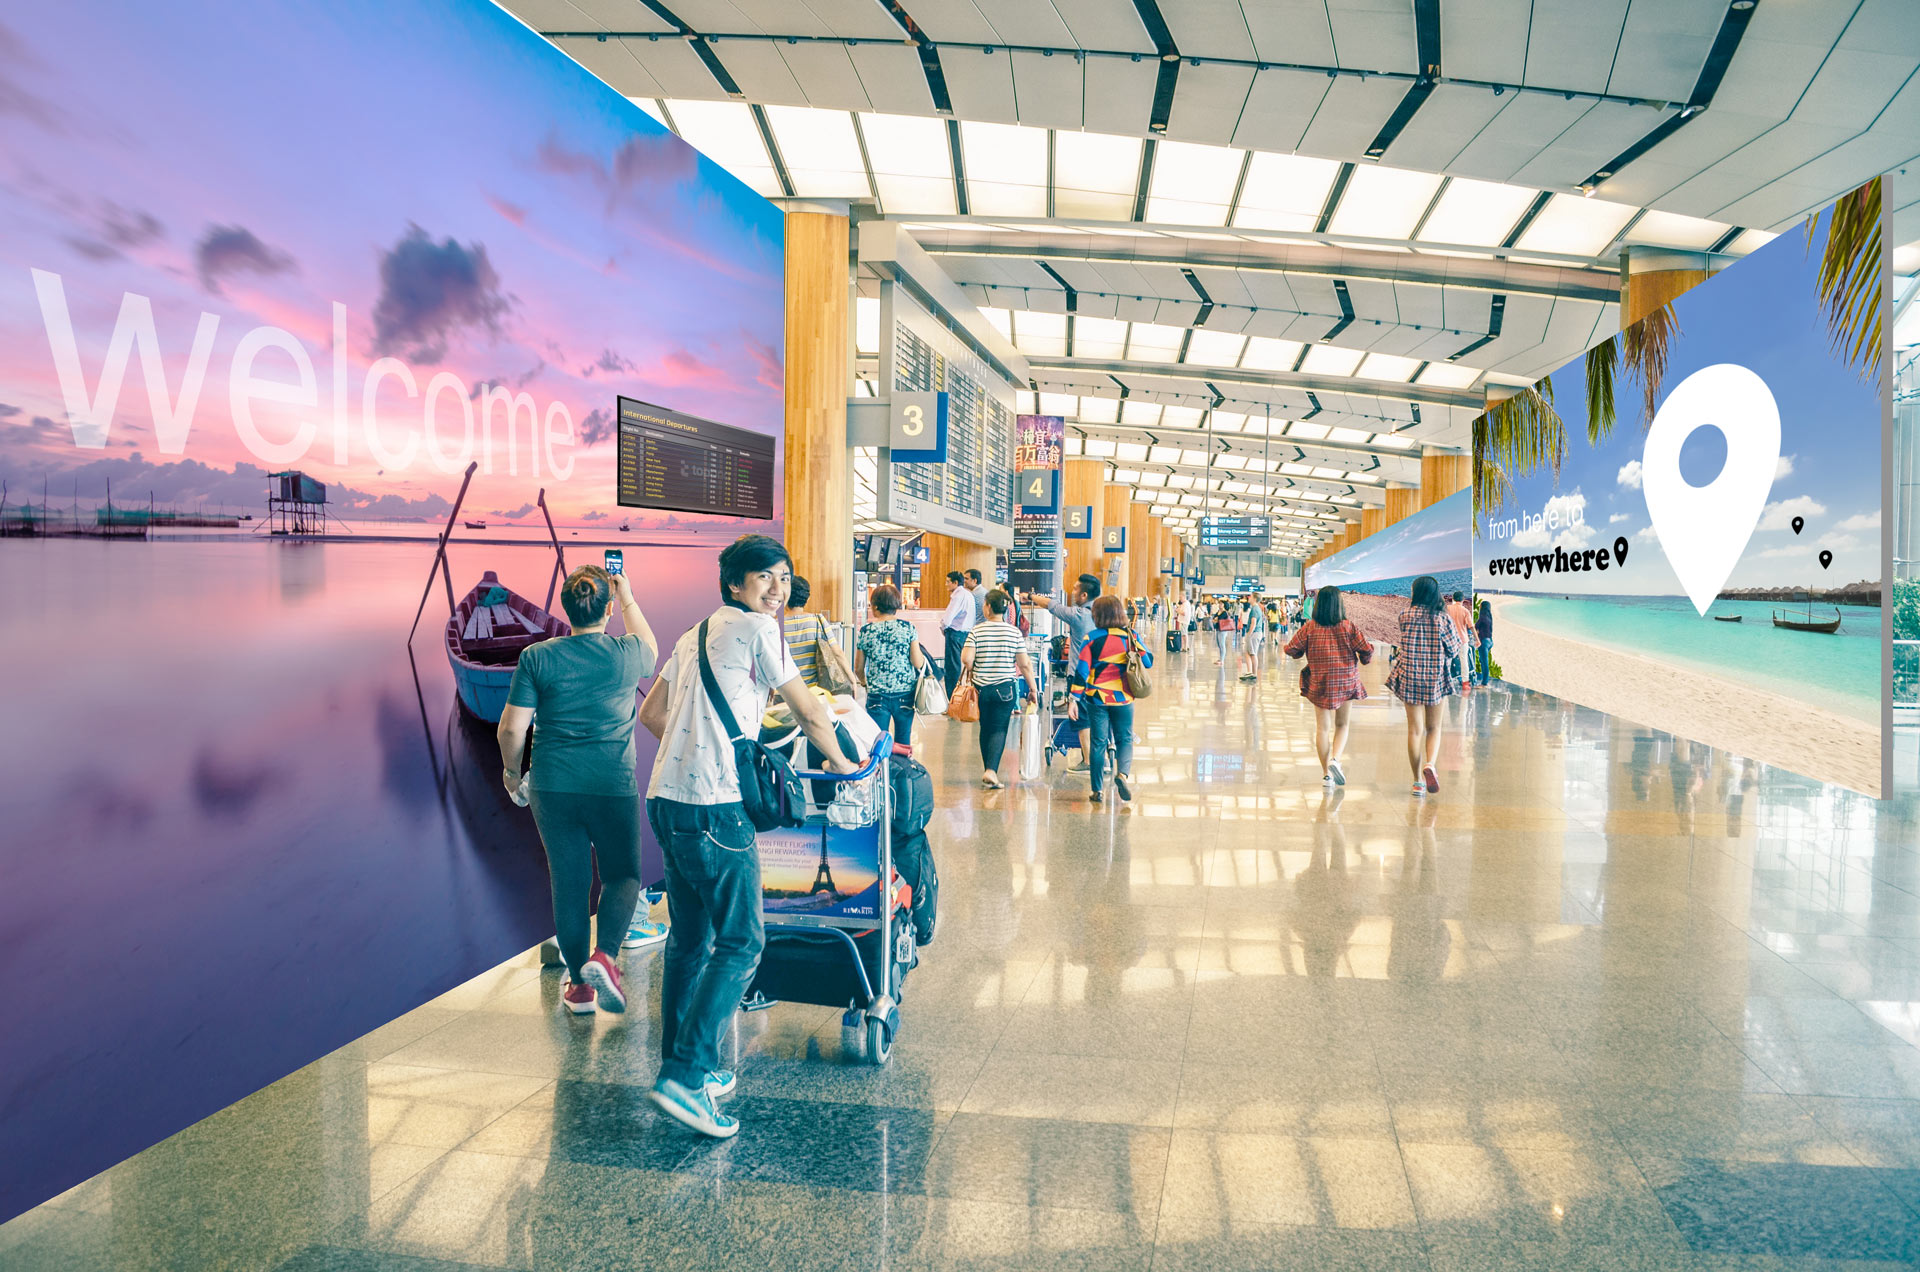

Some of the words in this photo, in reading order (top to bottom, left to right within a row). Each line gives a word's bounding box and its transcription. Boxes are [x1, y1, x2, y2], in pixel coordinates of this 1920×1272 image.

[31, 267, 576, 481] Welcome
[623, 409, 666, 425] International
[666, 419, 698, 433] Departures
[902, 405, 924, 437] 3
[1029, 477, 1044, 498] 4
[1070, 512, 1081, 527] 5
[1489, 517, 1518, 540] from
[1522, 510, 1559, 534] here
[1566, 503, 1584, 526] to
[1108, 531, 1117, 544] 6
[916, 548, 928, 562] 4
[1163, 559, 1170, 568] 7
[1489, 546, 1610, 580] everywhere
[774, 848, 806, 856] REWARDS
